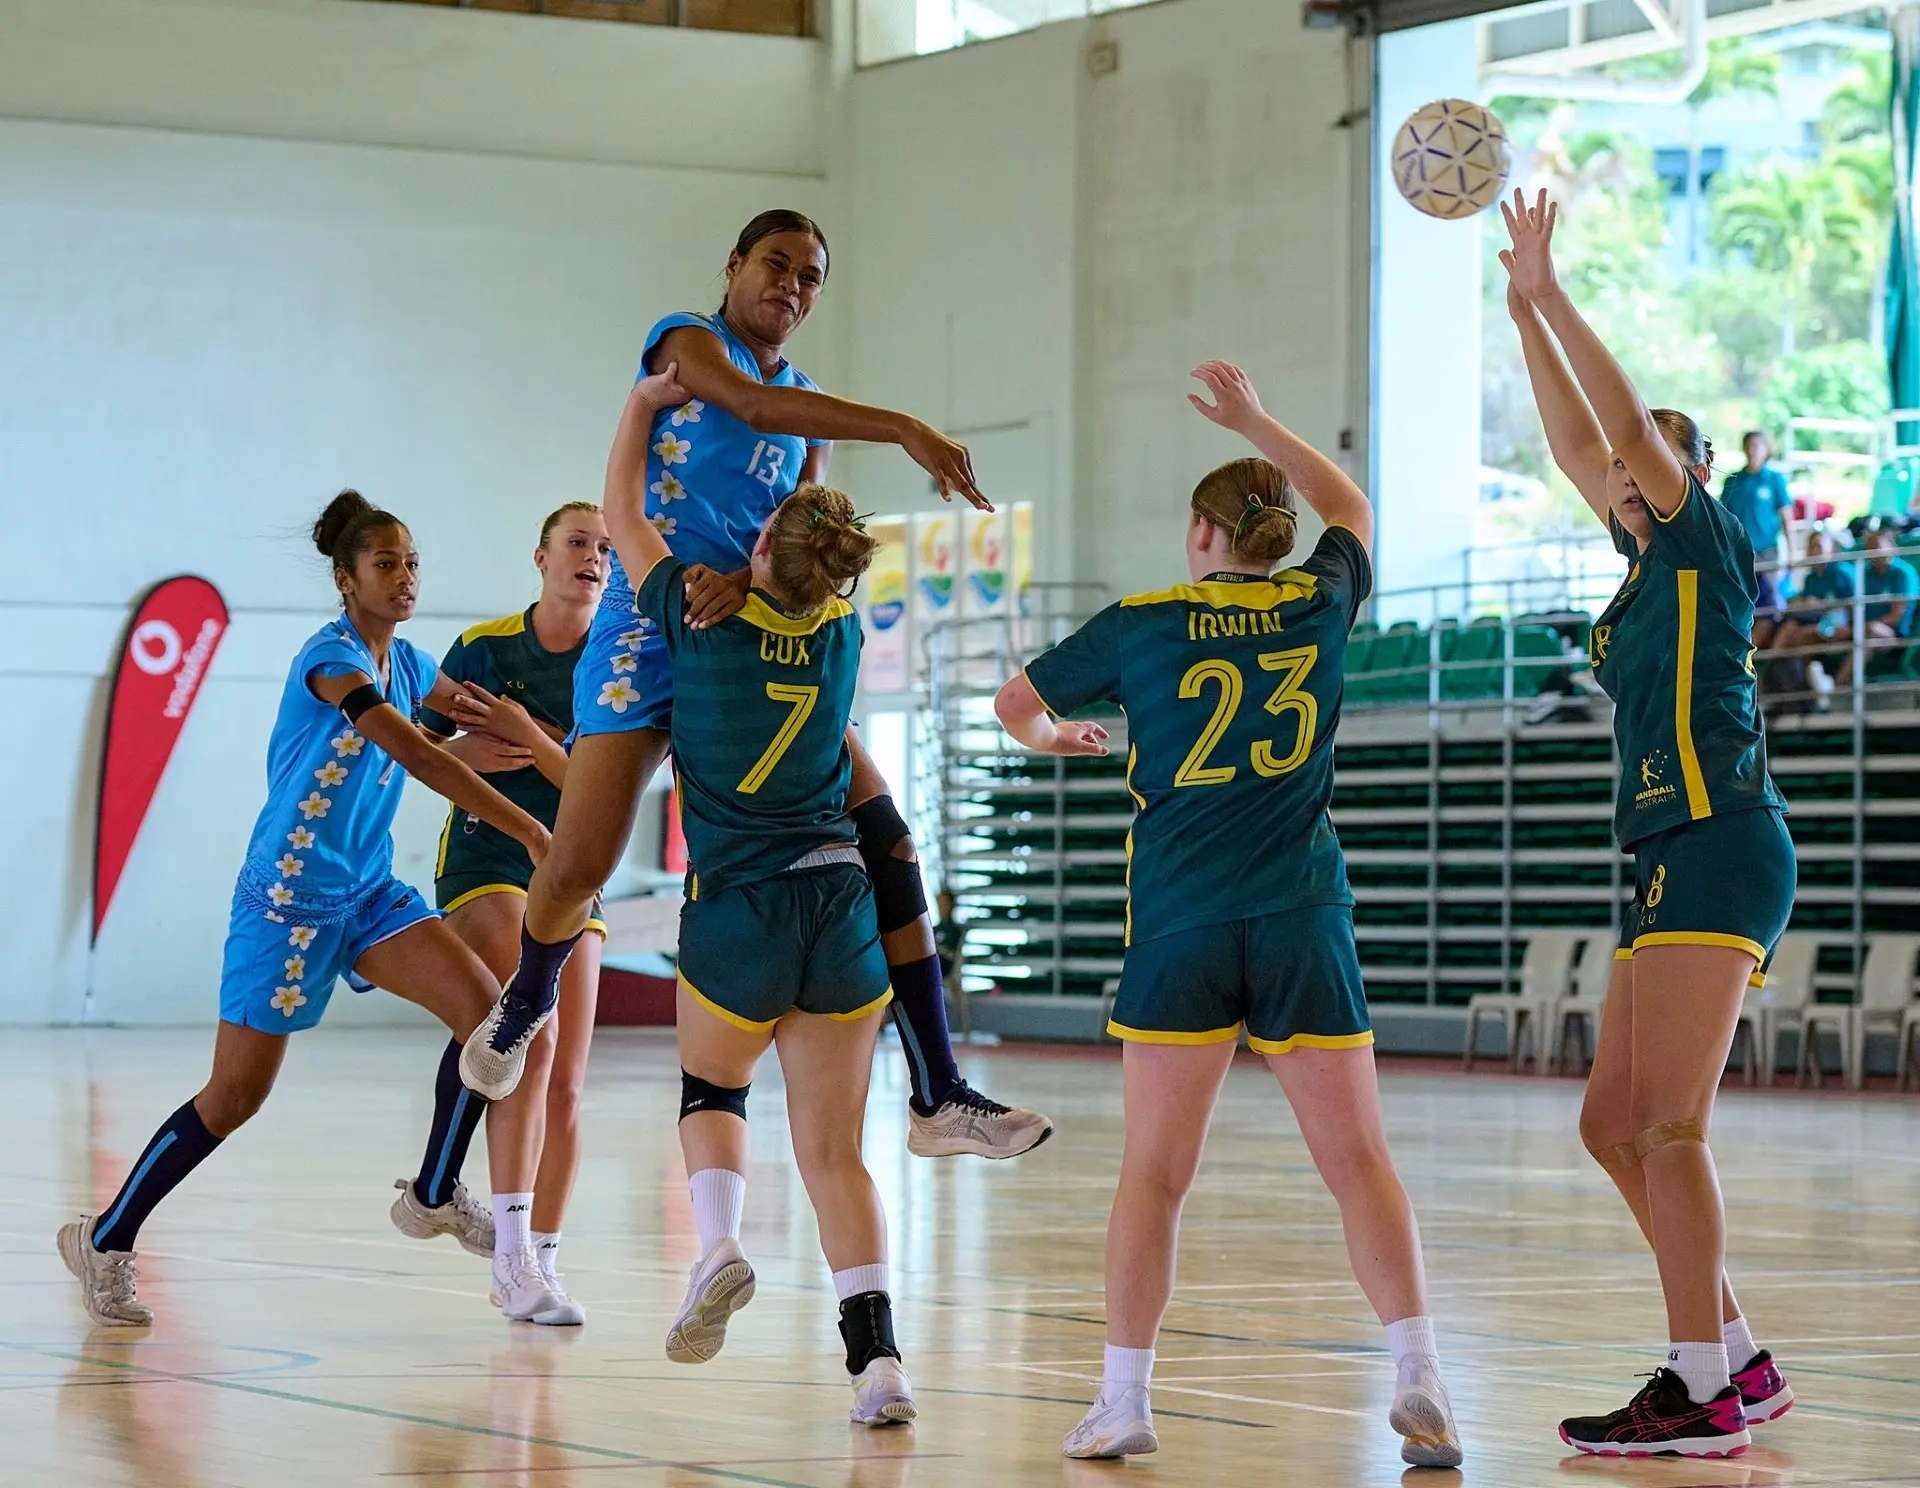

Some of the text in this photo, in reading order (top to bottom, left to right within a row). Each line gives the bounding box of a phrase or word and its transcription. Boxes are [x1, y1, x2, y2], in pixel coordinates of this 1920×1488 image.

[745, 440, 786, 487] 13
[1216, 573, 1245, 582] AUSTRALIA
[1188, 611, 1284, 641] IRWIN
[760, 631, 810, 666] COX
[1174, 644, 1318, 787] 23
[736, 681, 819, 794] 7
[1635, 784, 1676, 802] HANDBALL
[1635, 792, 1677, 811] AUSTRALIA
